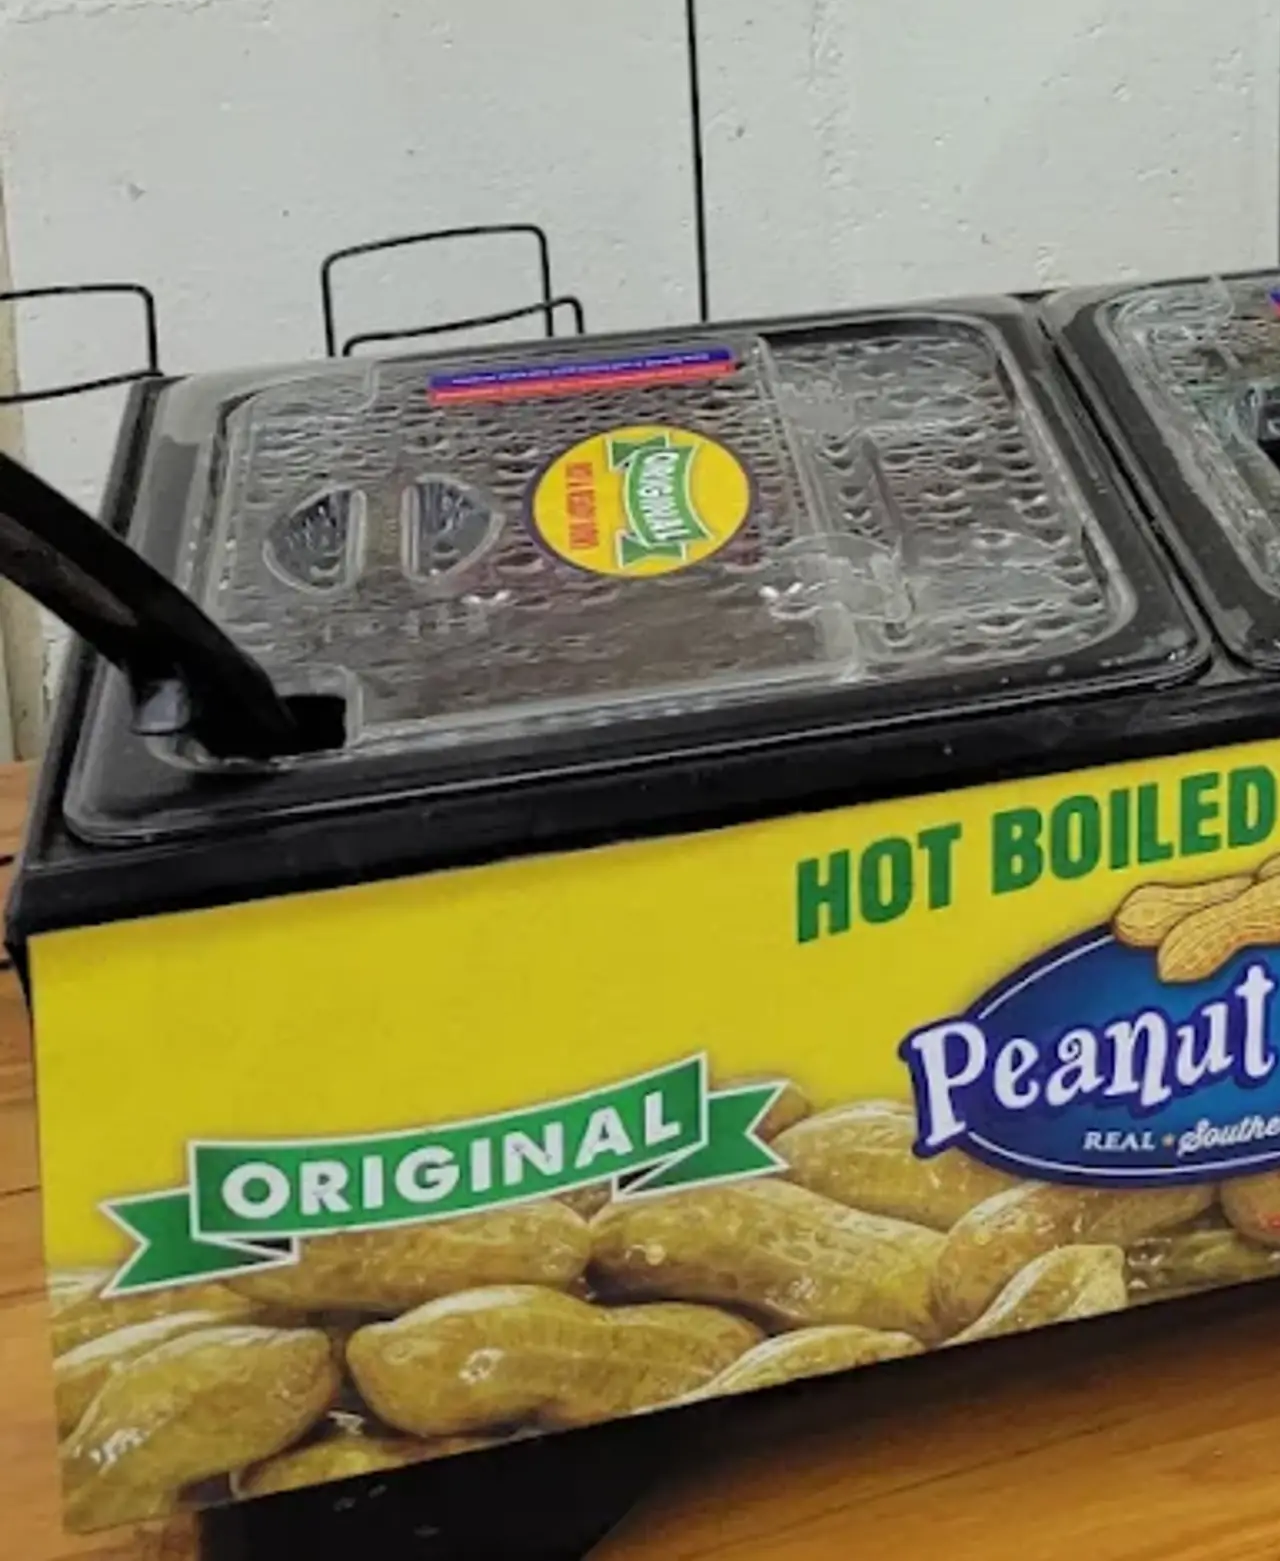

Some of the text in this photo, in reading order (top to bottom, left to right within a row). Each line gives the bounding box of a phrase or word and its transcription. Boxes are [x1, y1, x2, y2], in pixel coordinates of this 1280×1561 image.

[638, 452, 691, 540] ORIGINAL
[796, 823, 962, 944] HOT
[991, 764, 1278, 895] BOILED
[911, 965, 1278, 1149] Peanut
[222, 1091, 682, 1220] ORIGINAL
[1083, 1130, 1155, 1152] REAL
